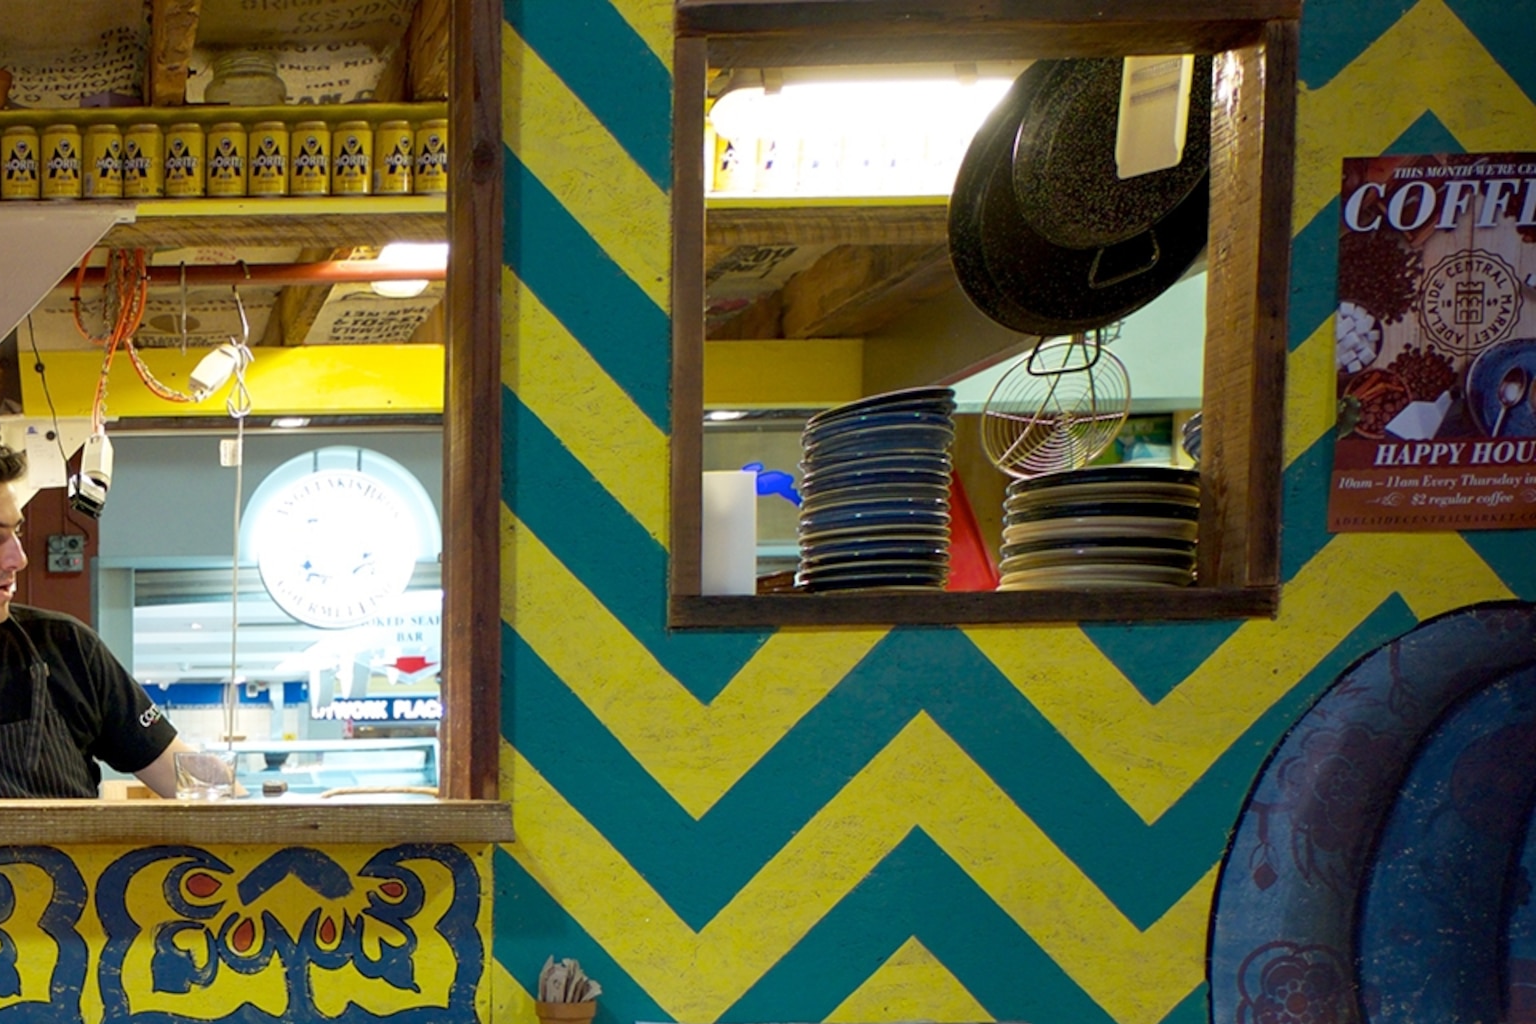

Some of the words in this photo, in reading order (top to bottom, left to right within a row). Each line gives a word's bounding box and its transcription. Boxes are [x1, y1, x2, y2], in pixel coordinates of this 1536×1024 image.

[1393, 167, 1424, 179] THIS
[1424, 165, 1473, 178] MONTH
[1445, 260, 1507, 289] CENTRAL
[1427, 280, 1464, 345] ADELAIDE
[1474, 294, 1512, 345] MARKET
[1373, 443, 1467, 467] HAPPY
[1470, 440, 1536, 465] HOU
[1339, 477, 1373, 490] 10am
[1386, 475, 1420, 488] 11am
[1422, 475, 1459, 490] Every
[1461, 473, 1522, 489] Thursday
[1410, 493, 1426, 506] $2
[1428, 493, 1473, 508] regular
[1476, 490, 1515, 507] coffee
